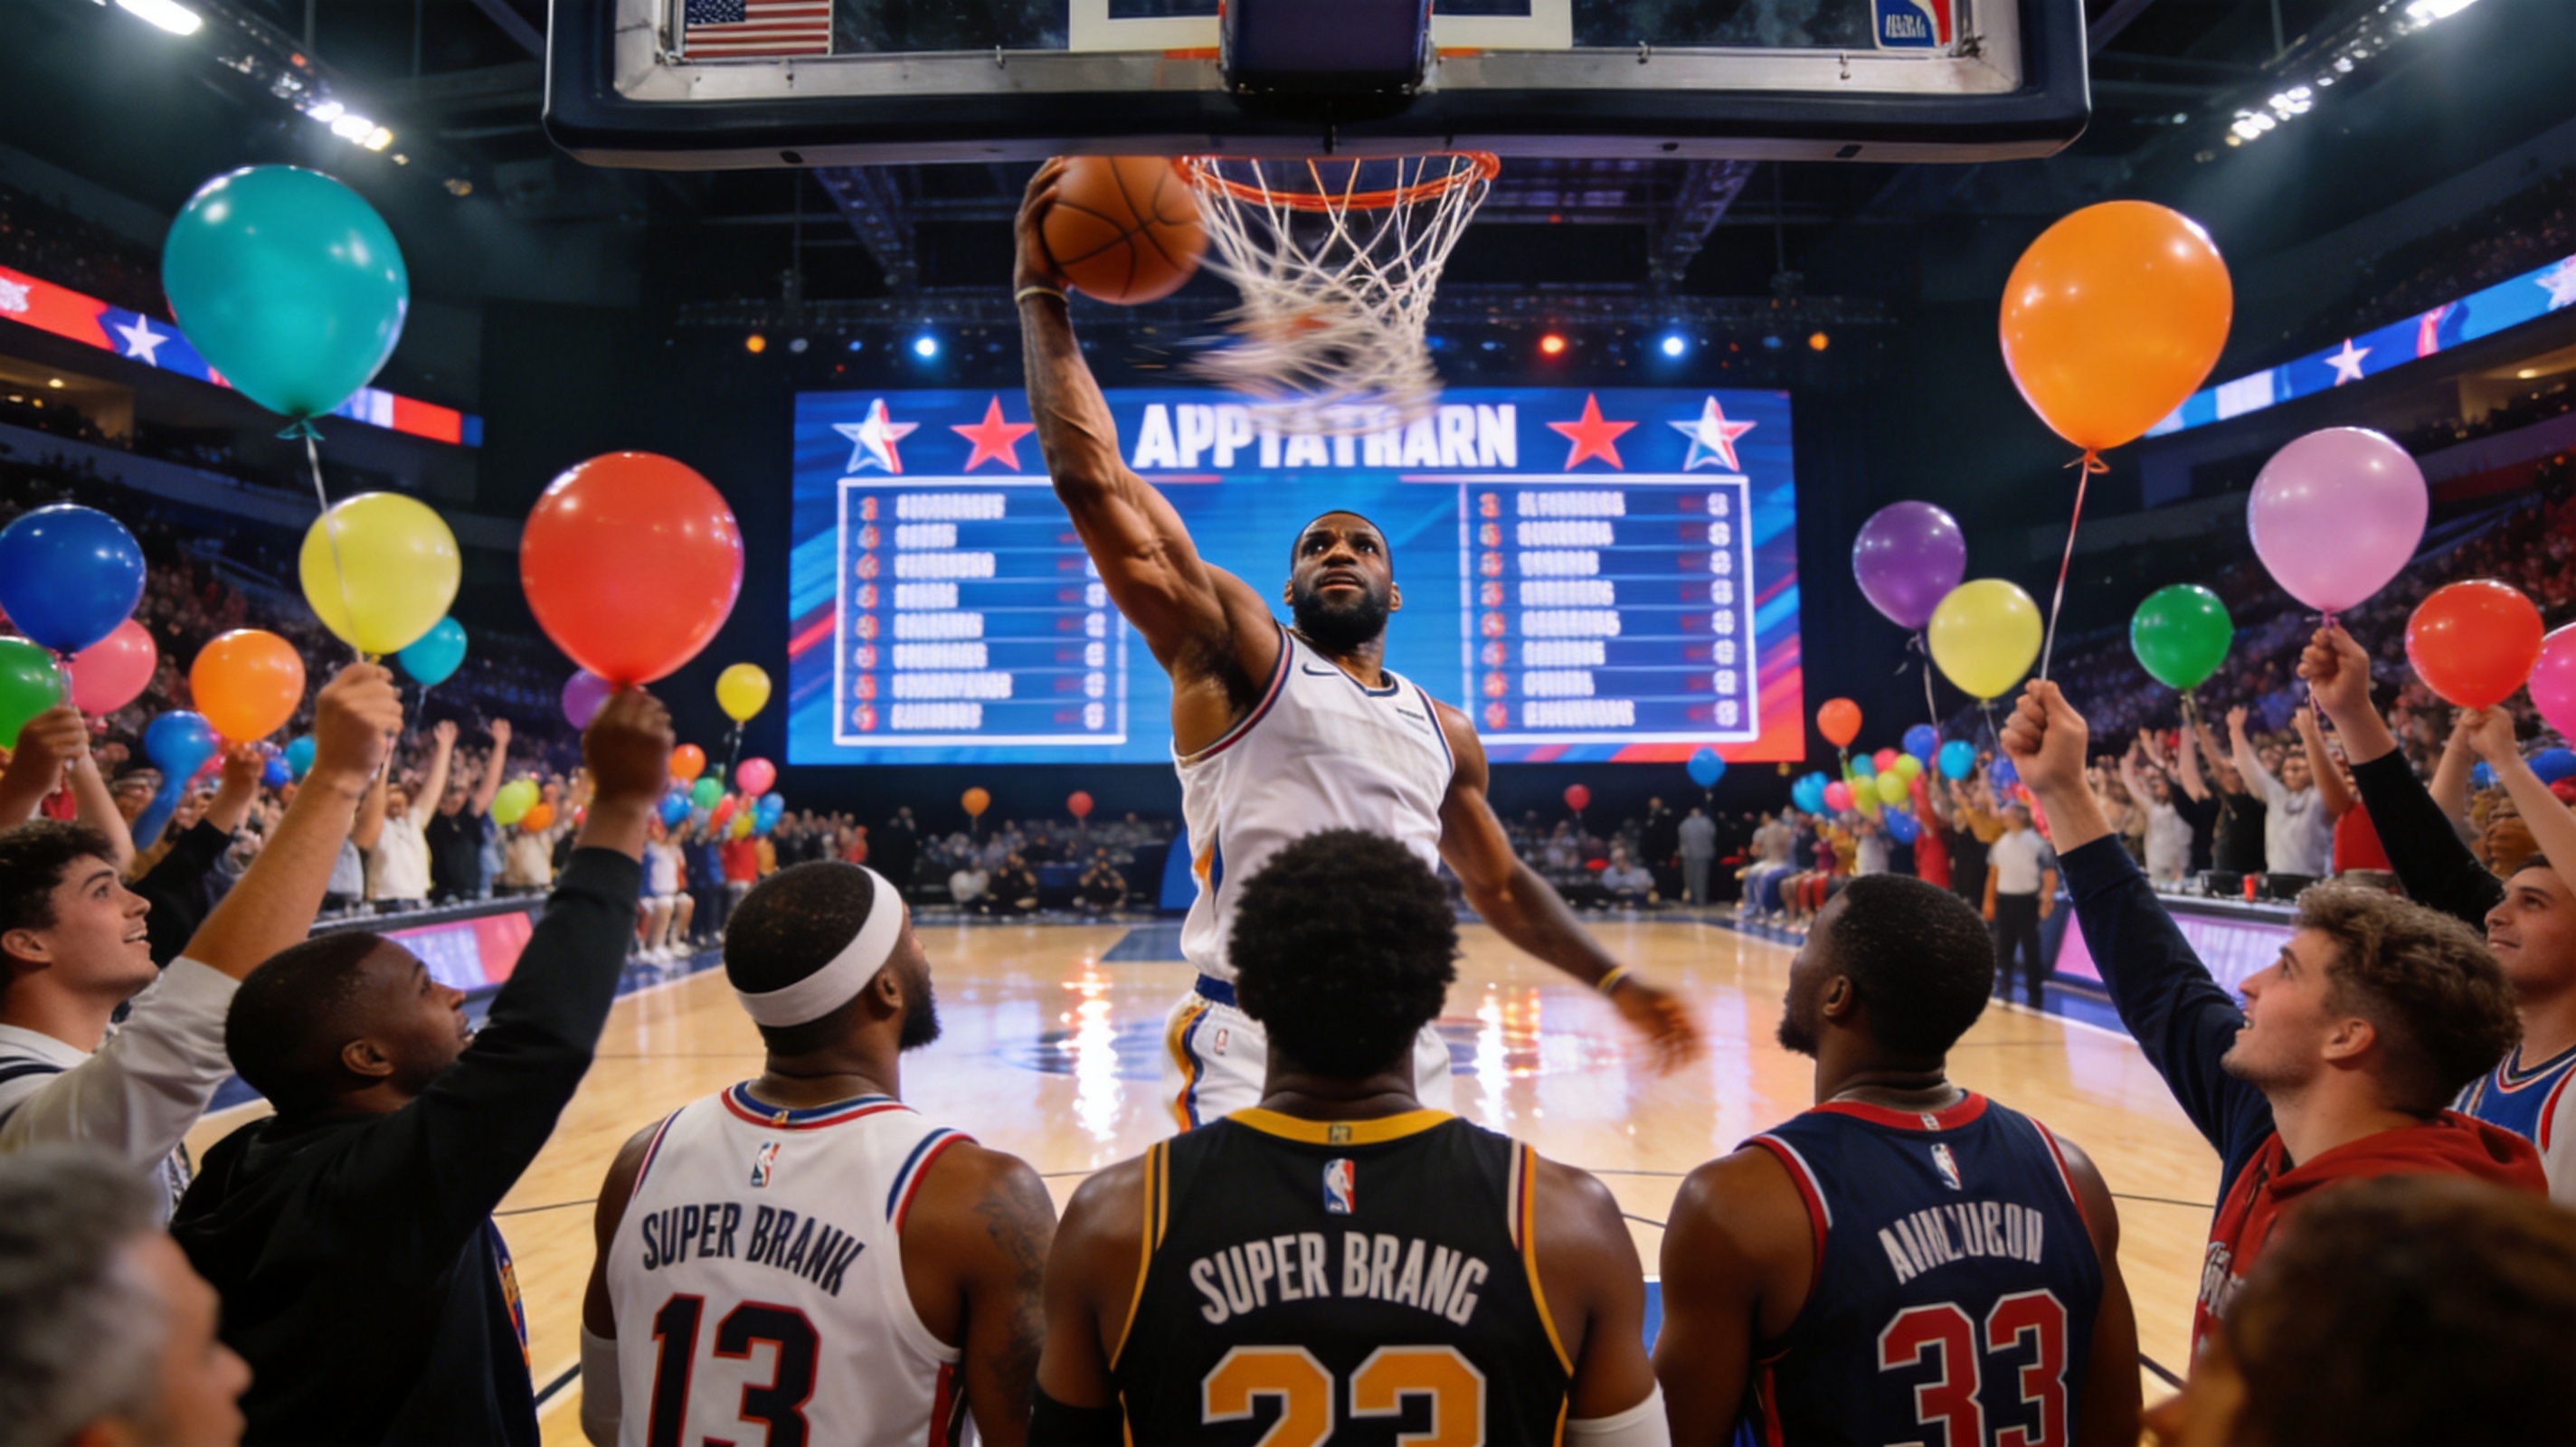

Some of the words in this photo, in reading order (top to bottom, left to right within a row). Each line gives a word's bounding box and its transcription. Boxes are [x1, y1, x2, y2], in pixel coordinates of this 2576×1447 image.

[641, 1202, 742, 1272] SUPER
[746, 1204, 866, 1298] BRANK
[1189, 1232, 1331, 1326] SUPER
[1341, 1230, 1490, 1328] BRANG
[646, 1291, 821, 1447] 13
[1878, 1287, 2069, 1447] 33
